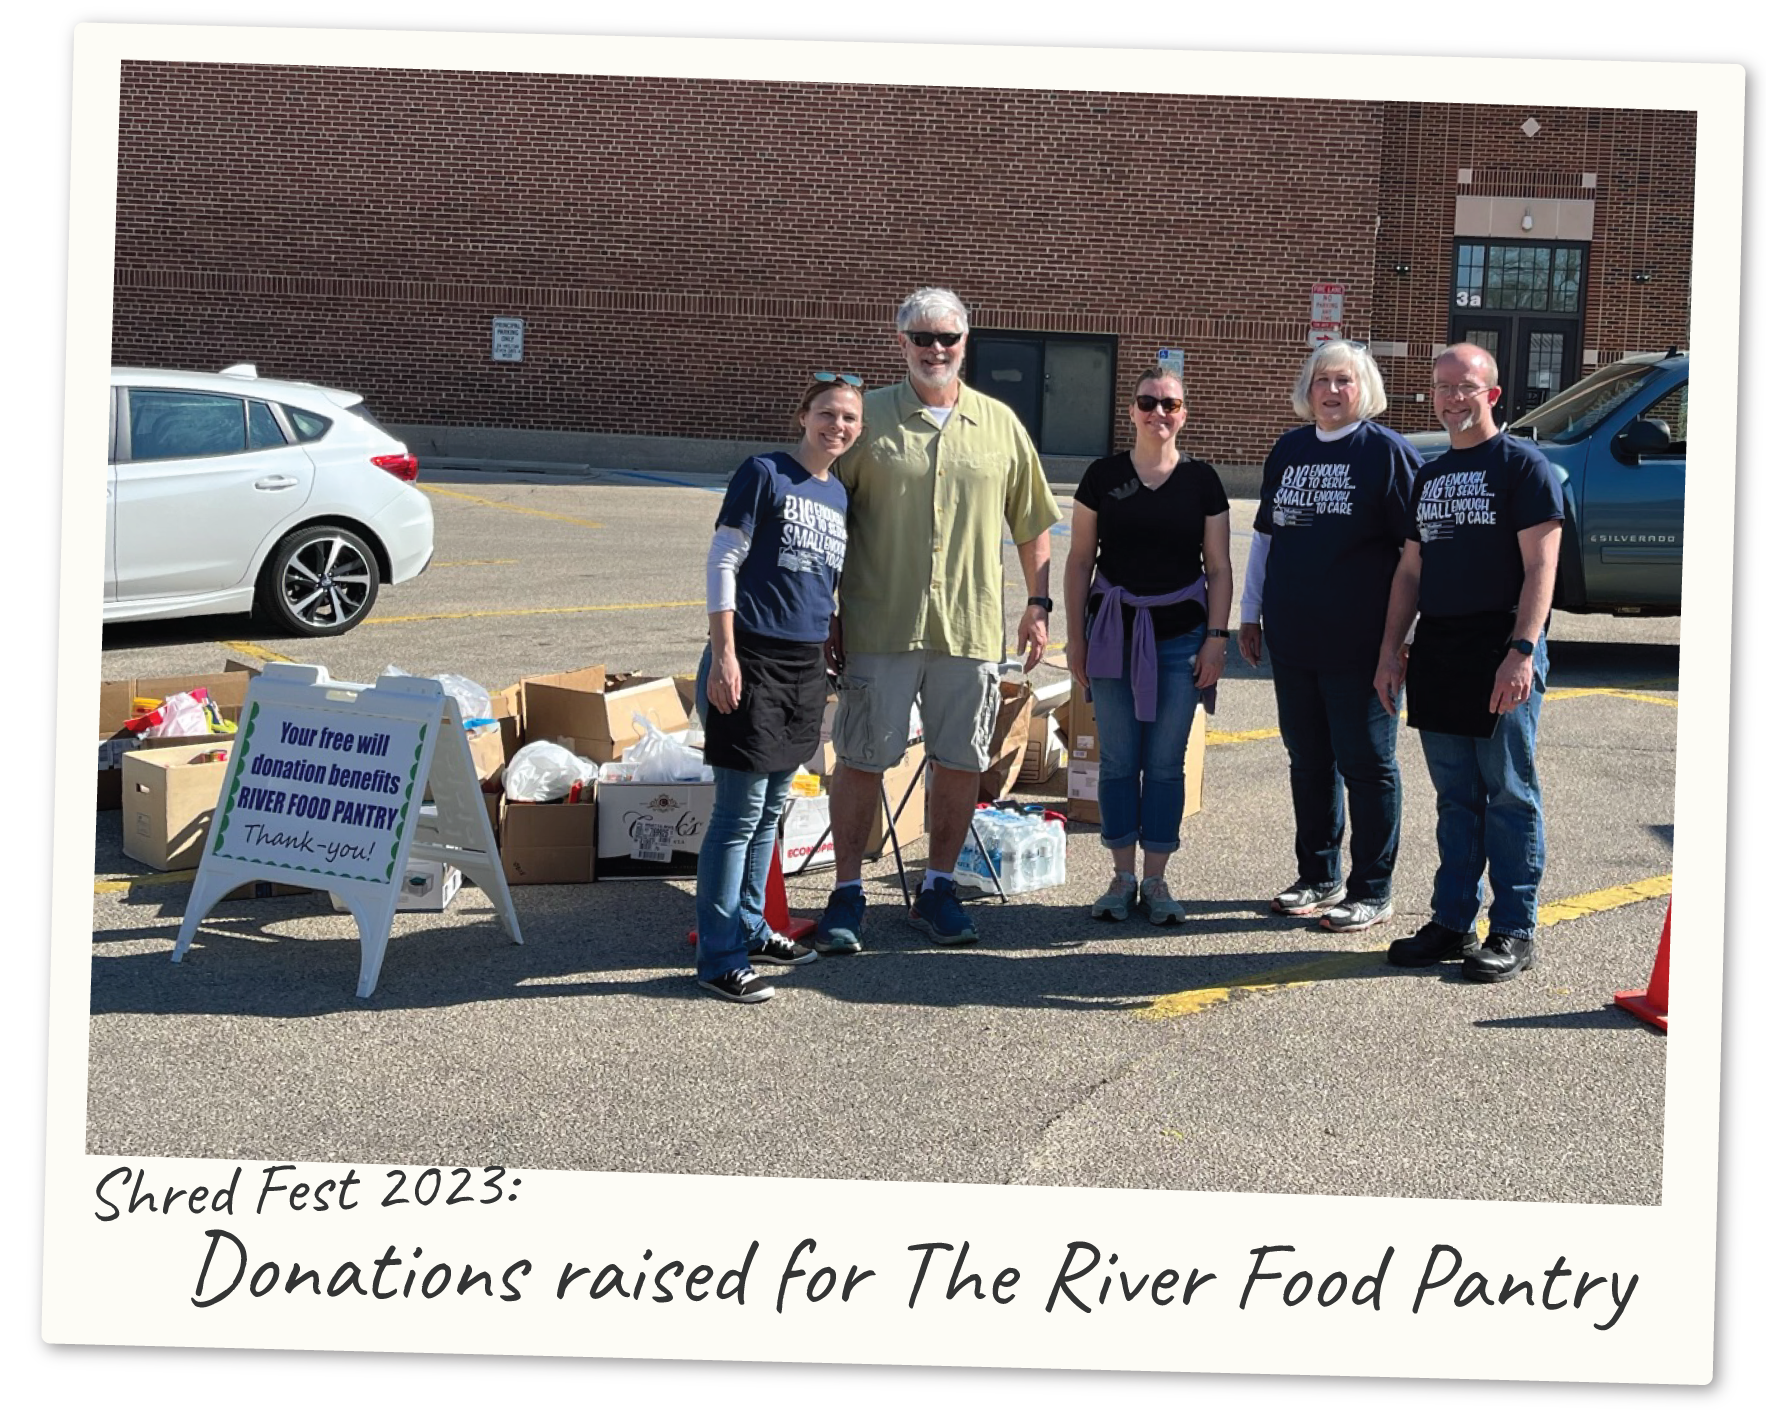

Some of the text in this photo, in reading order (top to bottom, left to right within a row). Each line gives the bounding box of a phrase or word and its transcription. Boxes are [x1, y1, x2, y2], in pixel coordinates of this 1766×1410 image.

[1456, 291, 1482, 307] 3a
[1281, 463, 1351, 488] BIG ENOUGH
[1308, 476, 1320, 489] TO
[1421, 470, 1487, 499] BIG ENOUGH
[1273, 488, 1351, 507] SMALL ENOUGH
[1445, 486, 1456, 499] TO
[783, 495, 816, 527] BIG
[1316, 502, 1353, 515] TO CARE
[1416, 498, 1490, 522] SMALL ENOUGH
[1454, 510, 1497, 525] TO CARE
[781, 523, 825, 554] SMALL
[1599, 534, 1675, 543] SILVERADO
[280, 721, 391, 757] Your free will
[251, 754, 401, 795] donation benefits
[237, 785, 399, 831] RIVER FOOD PANTRY
[244, 824, 376, 862] Thank-you!
